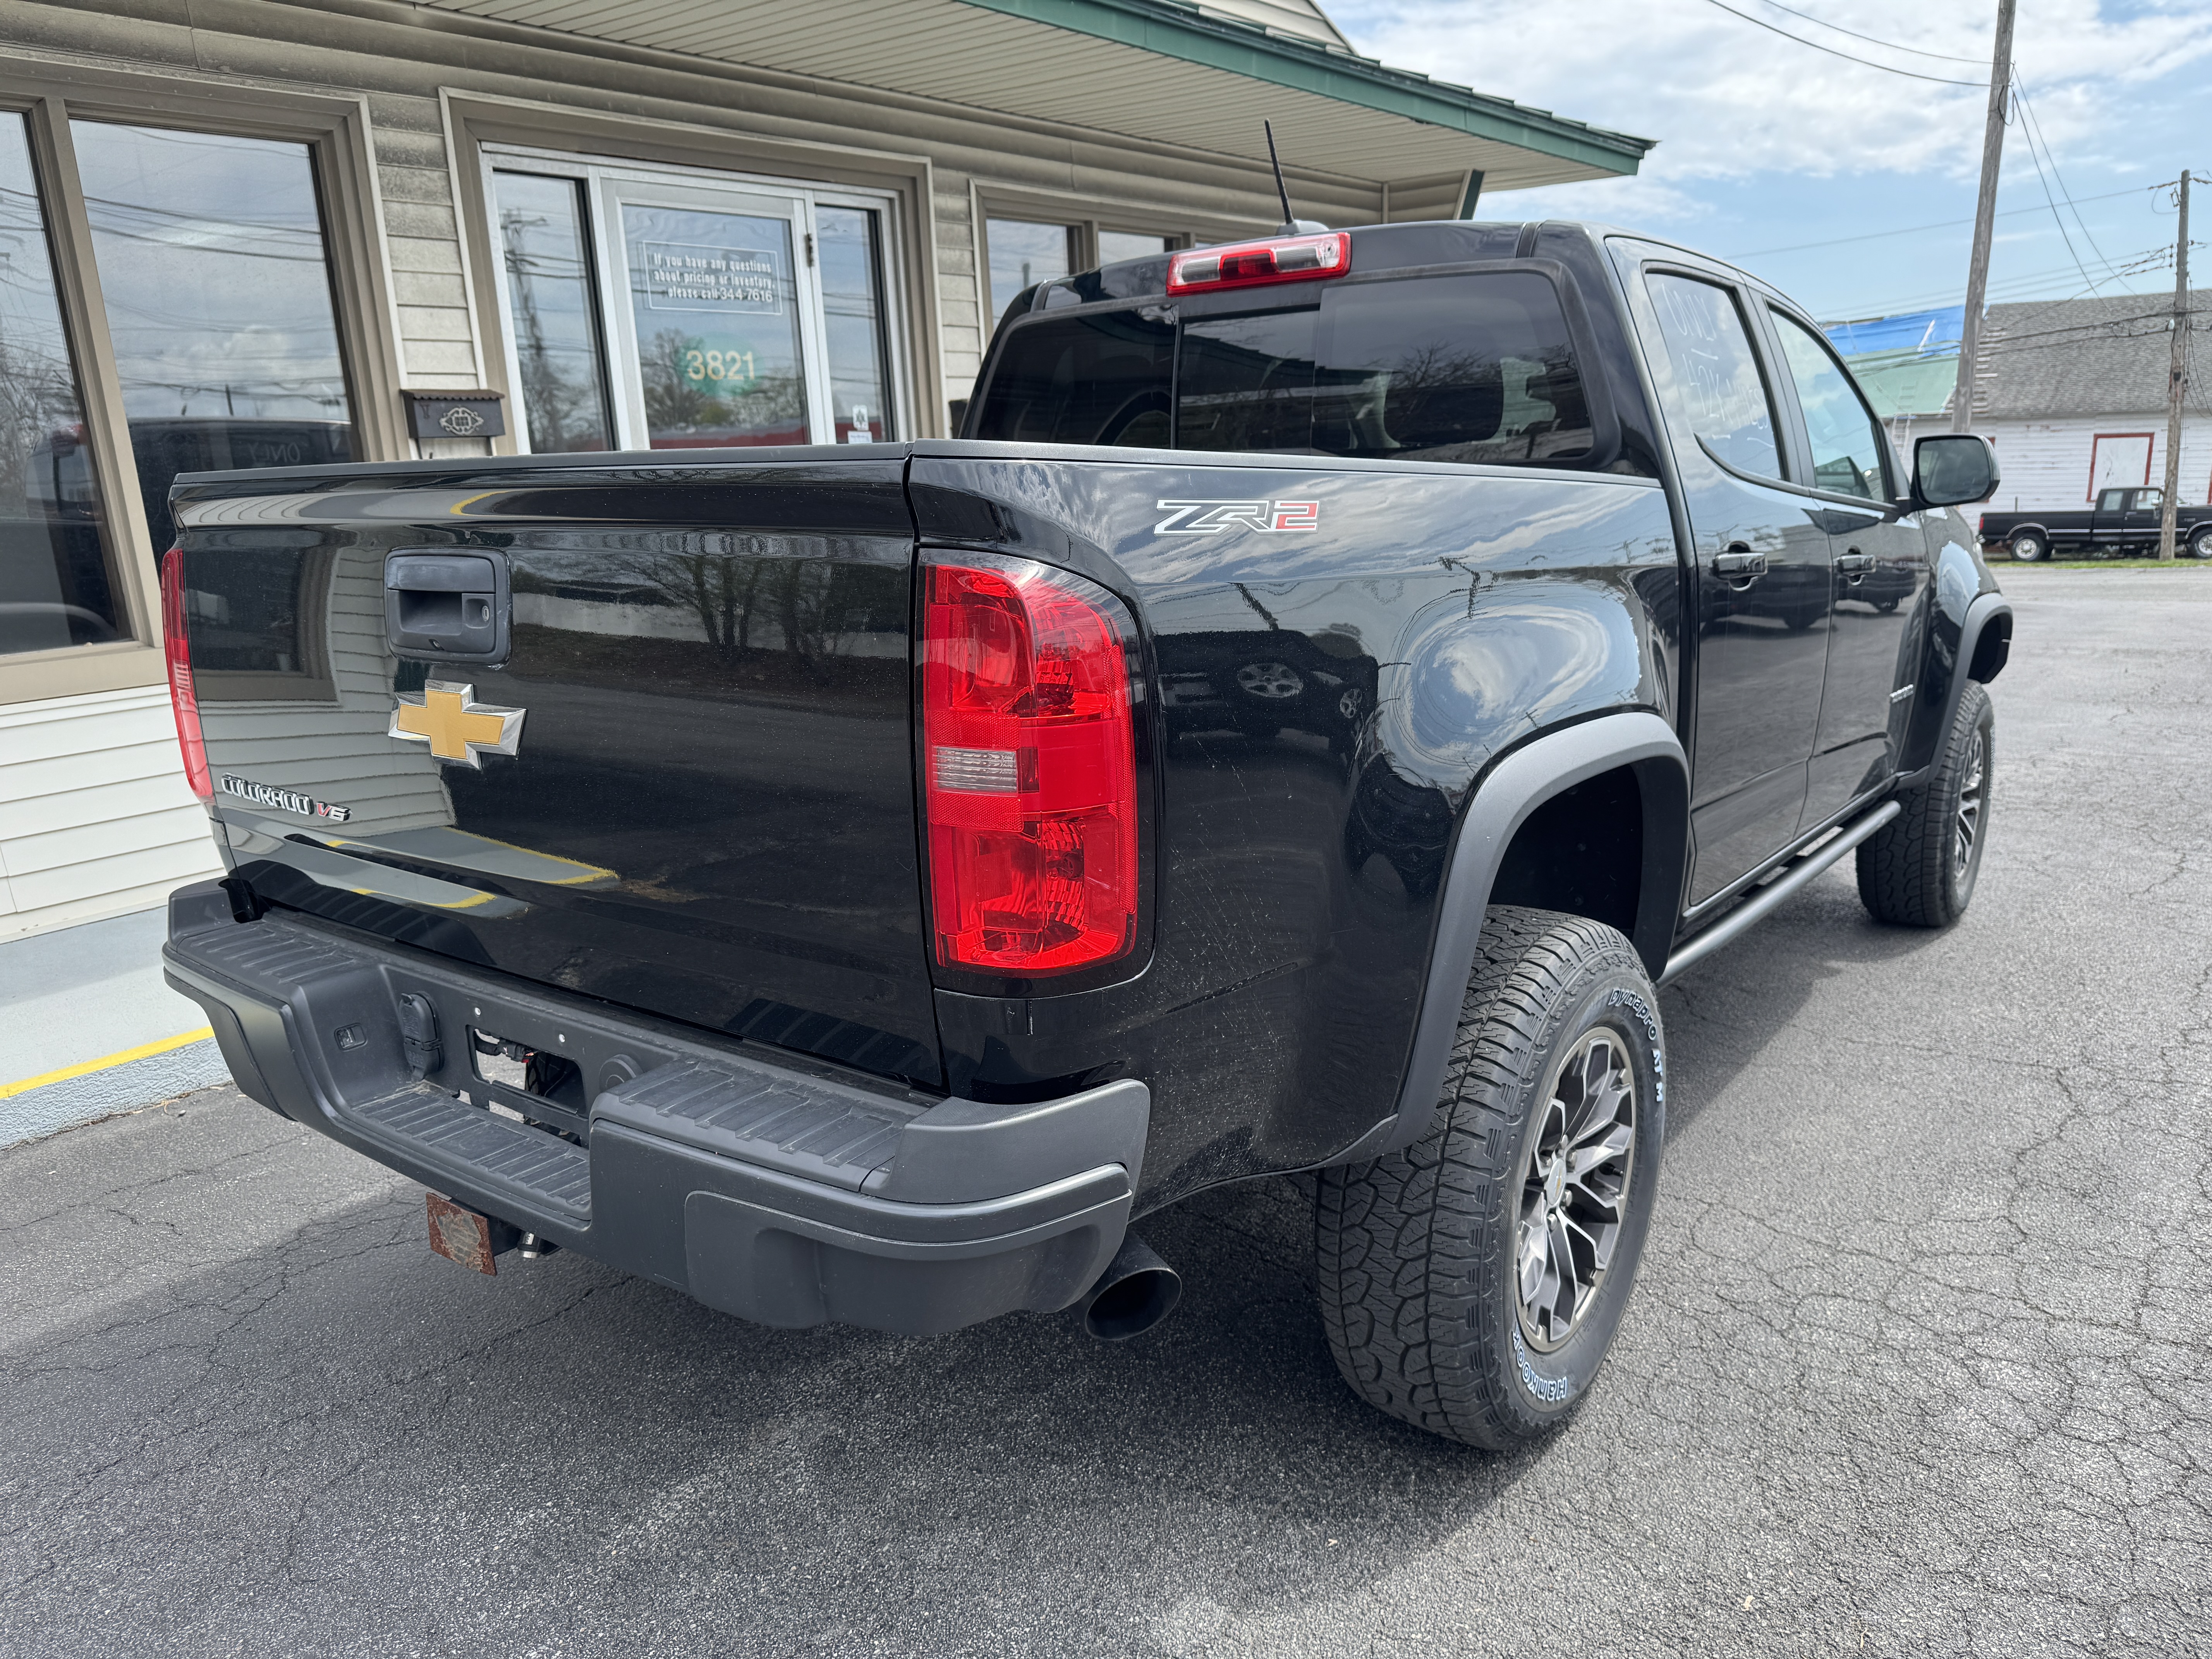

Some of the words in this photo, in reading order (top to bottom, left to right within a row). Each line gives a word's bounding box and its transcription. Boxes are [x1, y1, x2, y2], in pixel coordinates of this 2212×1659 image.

[653, 252, 661, 266] If
[665, 256, 682, 268] you
[685, 254, 707, 268] have
[710, 259, 726, 271] any
[729, 259, 772, 273] questions
[653, 268, 680, 283] about
[683, 271, 715, 286] pricing
[719, 275, 728, 285] or
[668, 285, 698, 299] please
[686, 350, 755, 380] 3821
[1153, 498, 1321, 537] ZR2
[221, 773, 314, 815] COLORADO
[316, 801, 352, 822] V6
